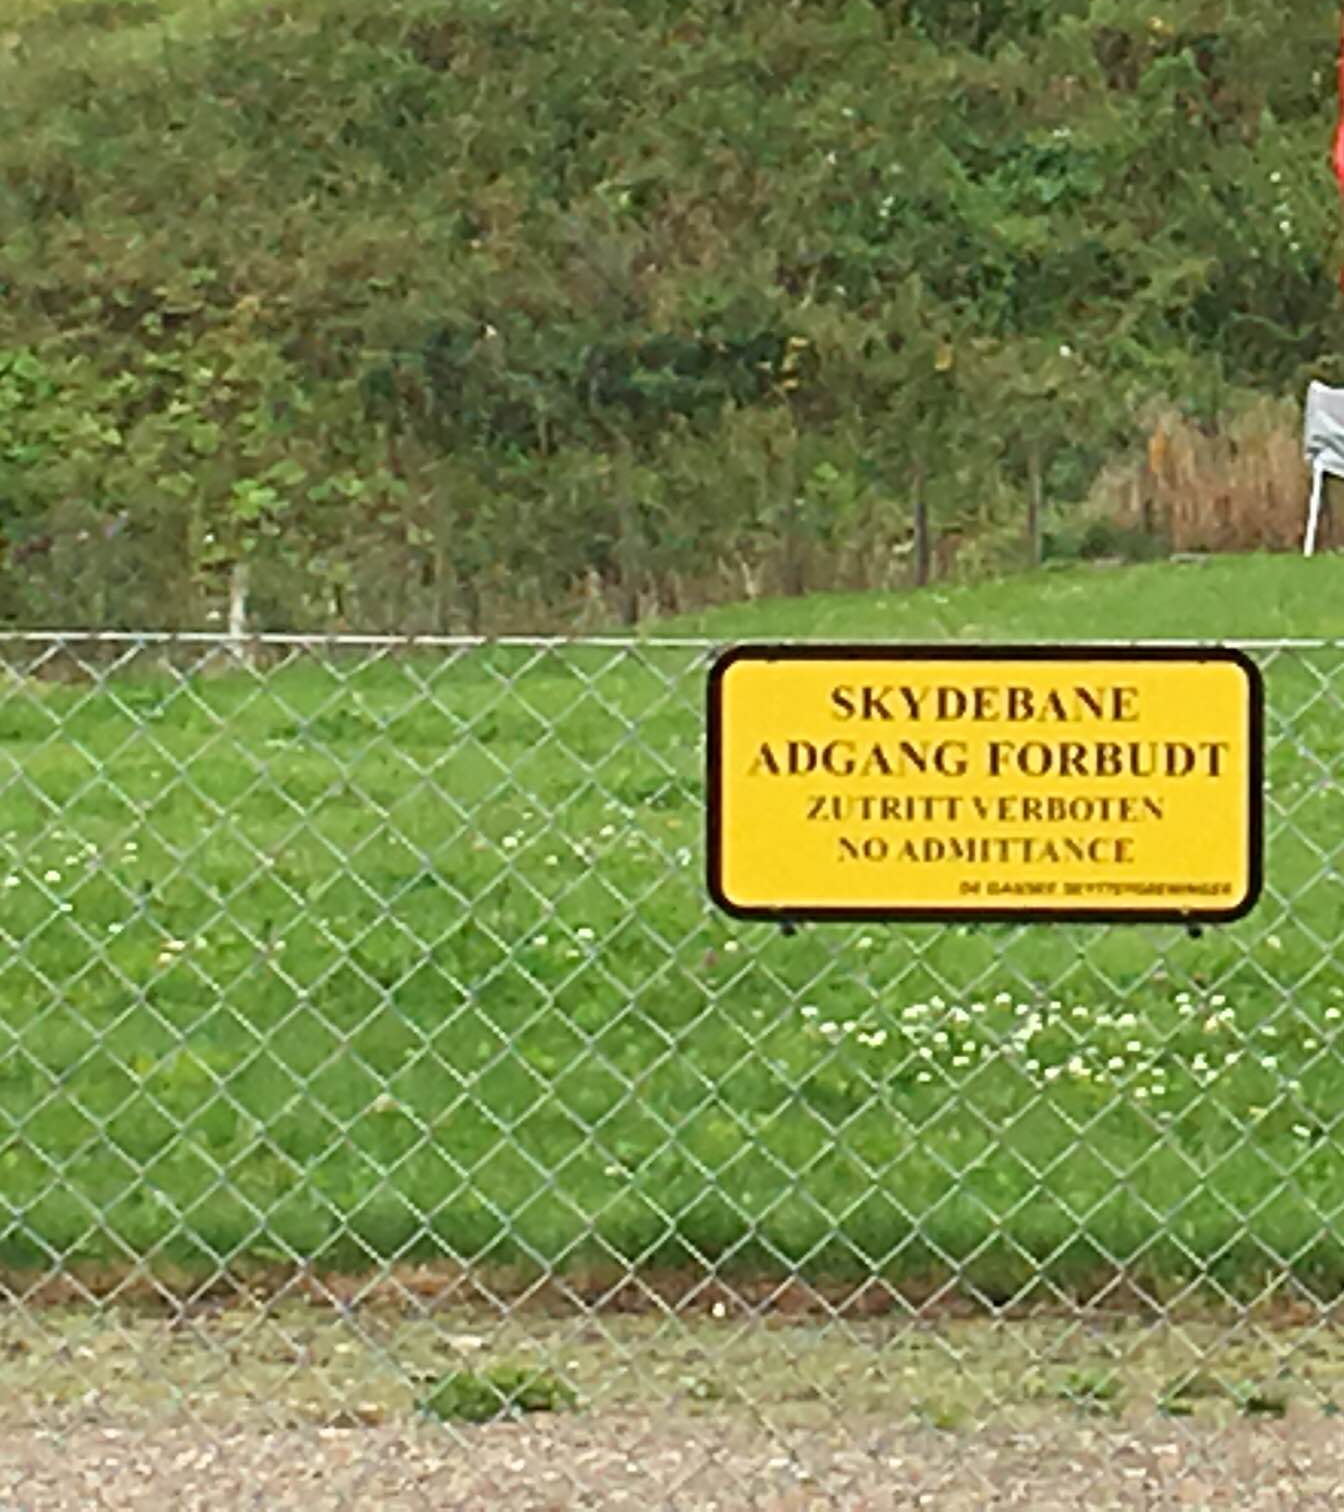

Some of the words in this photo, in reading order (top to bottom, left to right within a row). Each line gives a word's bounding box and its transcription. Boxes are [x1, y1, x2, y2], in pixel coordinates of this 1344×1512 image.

[830, 684, 1140, 722] SKYDEBANE
[747, 739, 968, 778] ADGANG
[987, 740, 1231, 778] FORBUDT
[806, 795, 965, 822] ZUTRITT
[971, 795, 1165, 822] VERBOTEN
[837, 836, 889, 863] NO
[900, 836, 1135, 864] ADMITTANCE
